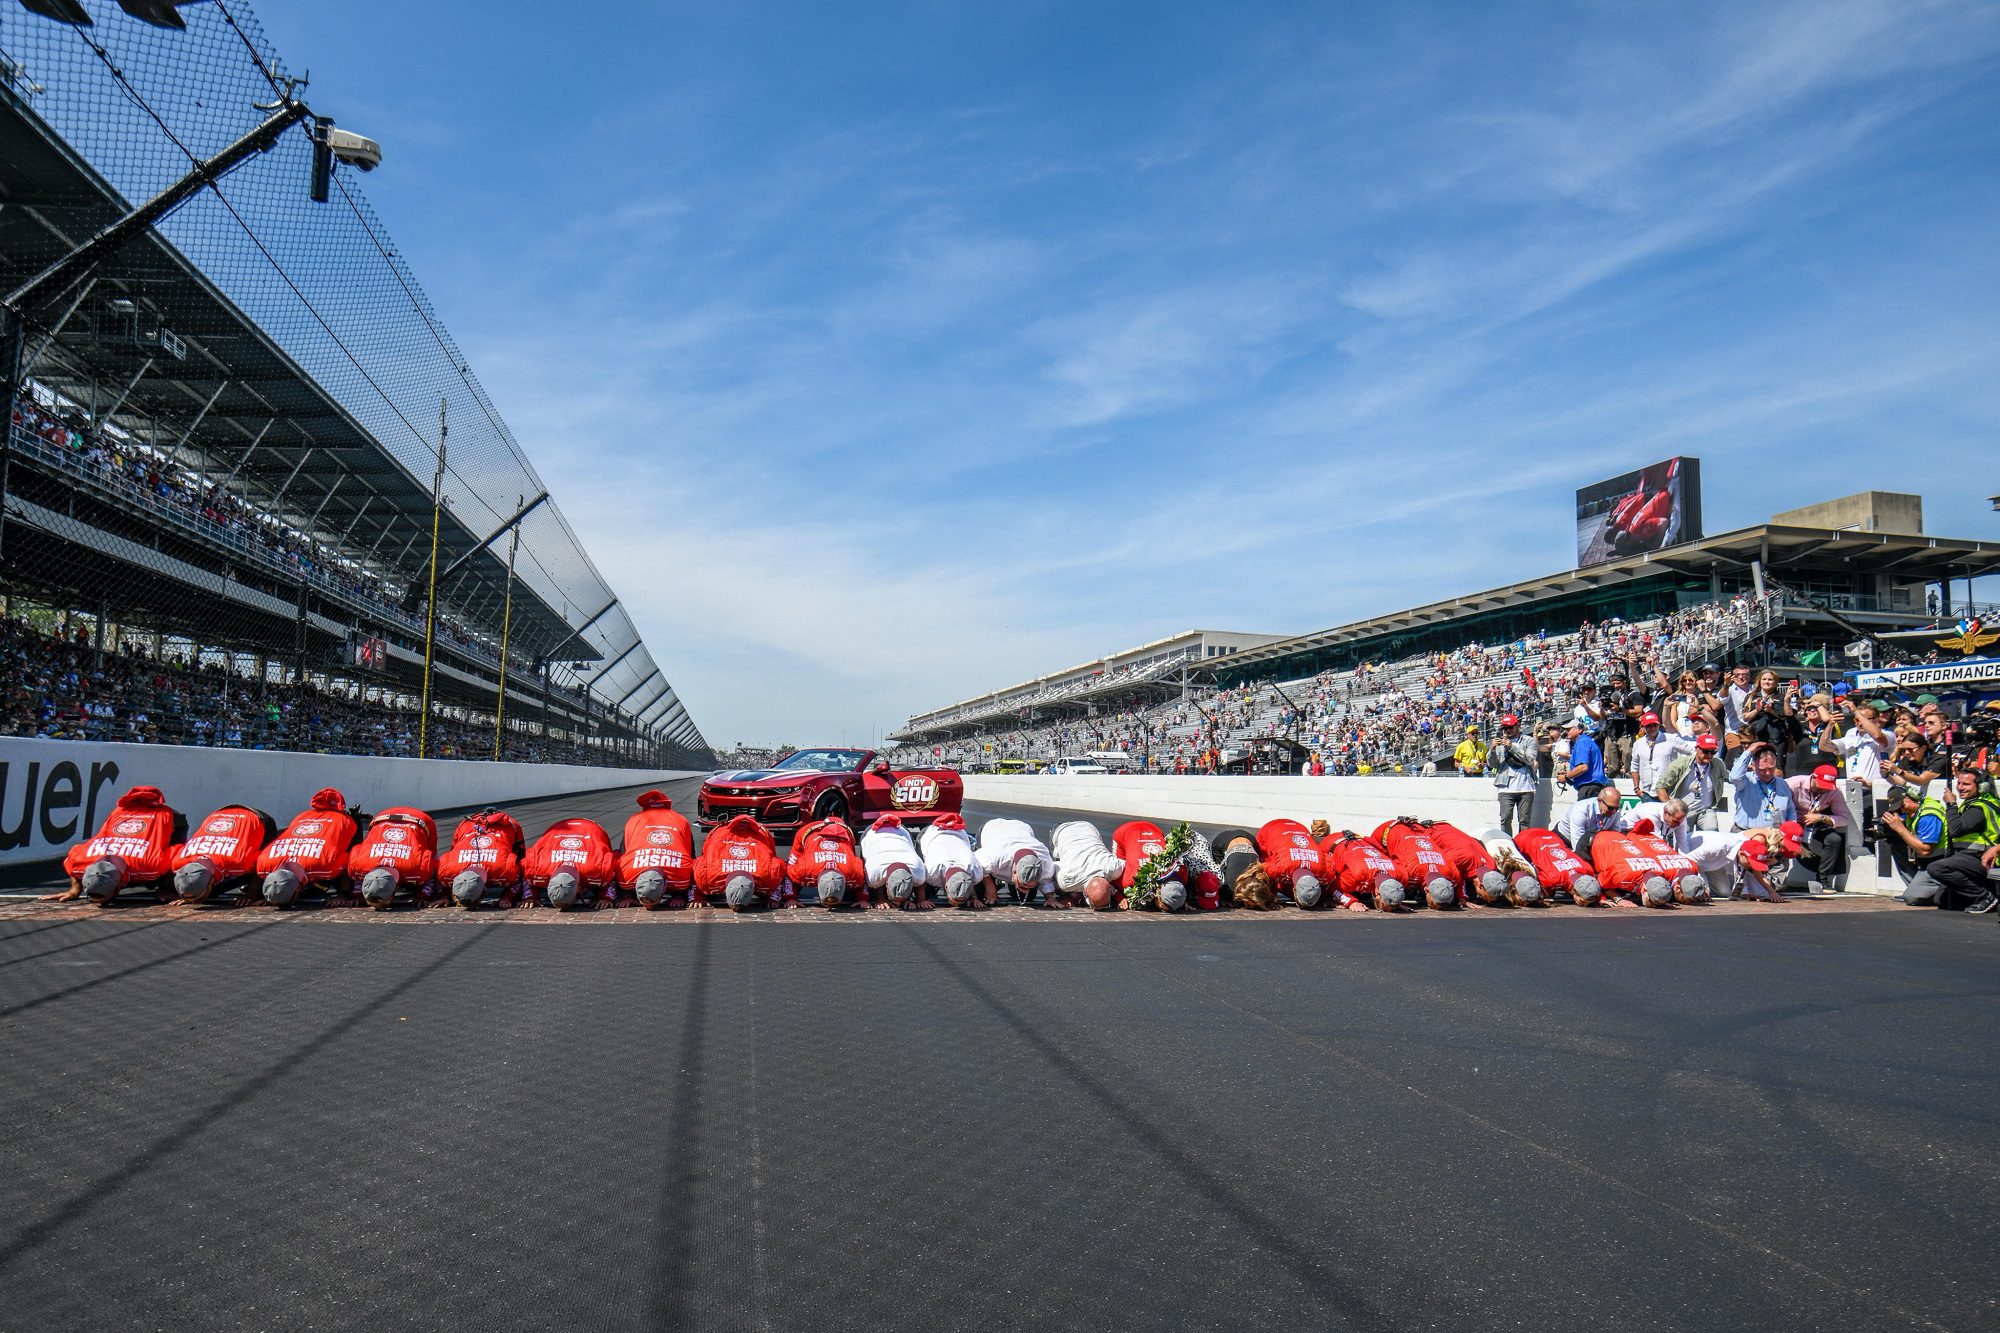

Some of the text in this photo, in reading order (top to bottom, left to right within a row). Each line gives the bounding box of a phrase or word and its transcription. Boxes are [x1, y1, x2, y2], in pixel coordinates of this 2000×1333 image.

[1899, 664, 2000, 684] PERFORMANCE
[904, 779, 926, 787] INDY
[896, 785, 934, 803] 500
[86, 843, 148, 859] HUSKI
[180, 842, 237, 859] HUSKI
[269, 843, 324, 859] HUSKI
[369, 846, 412, 860] HUSKI
[458, 853, 497, 864] HUSKI
[551, 853, 587, 864] HUSKI
[632, 854, 682, 869] HUSKI
[814, 853, 847, 865] HUSKI
[1660, 859, 1693, 870] HUSKI
[721, 863, 757, 873] HUSKI
